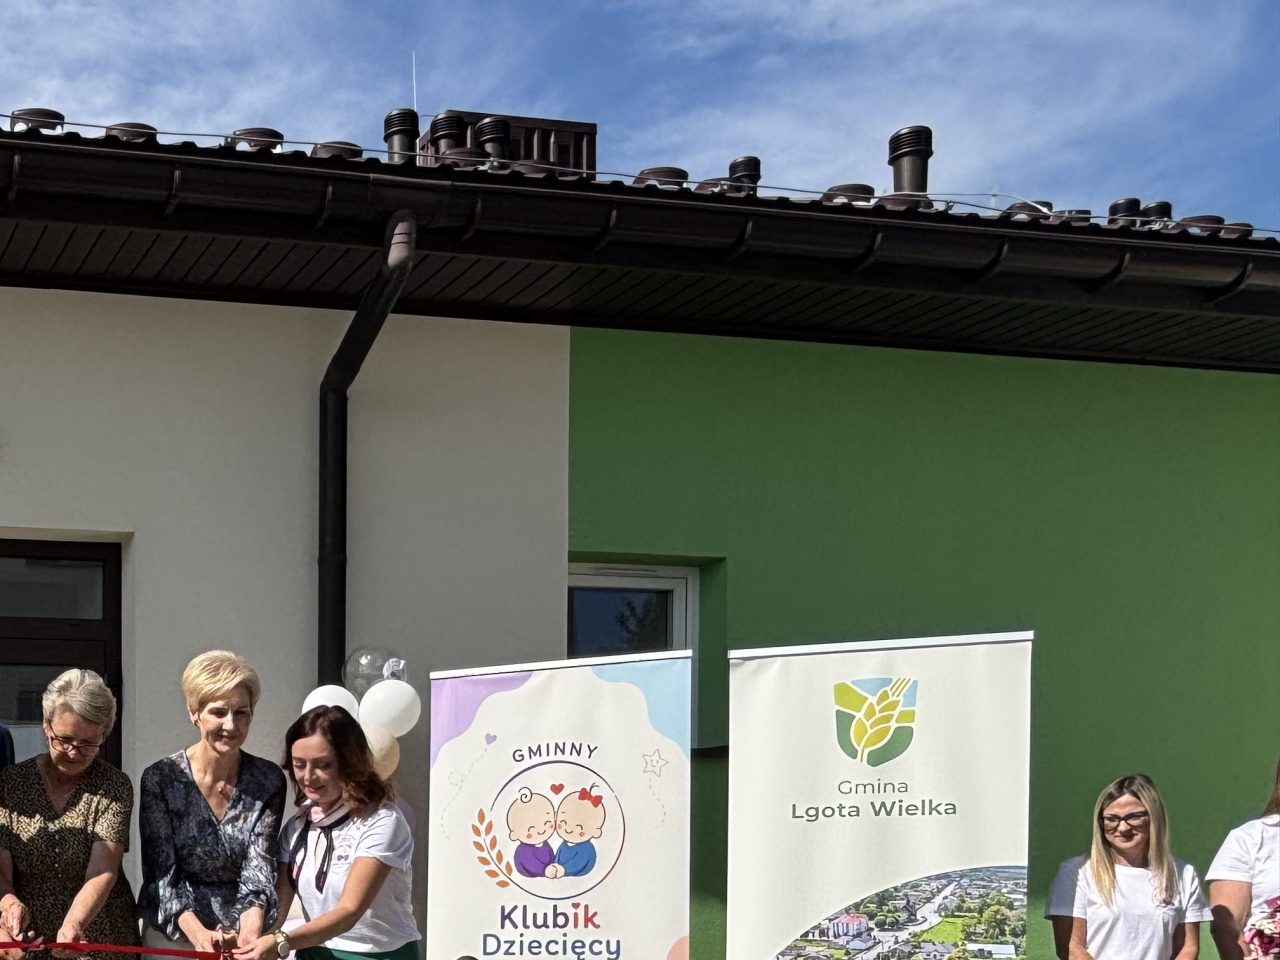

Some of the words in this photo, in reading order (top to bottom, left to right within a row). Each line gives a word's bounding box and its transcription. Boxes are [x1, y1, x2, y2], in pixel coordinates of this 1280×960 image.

[512, 741, 598, 763] GMINNY
[838, 778, 909, 795] Gmina
[791, 802, 860, 822] Lgota
[870, 799, 957, 817] Wielka
[500, 901, 601, 930] Klubik
